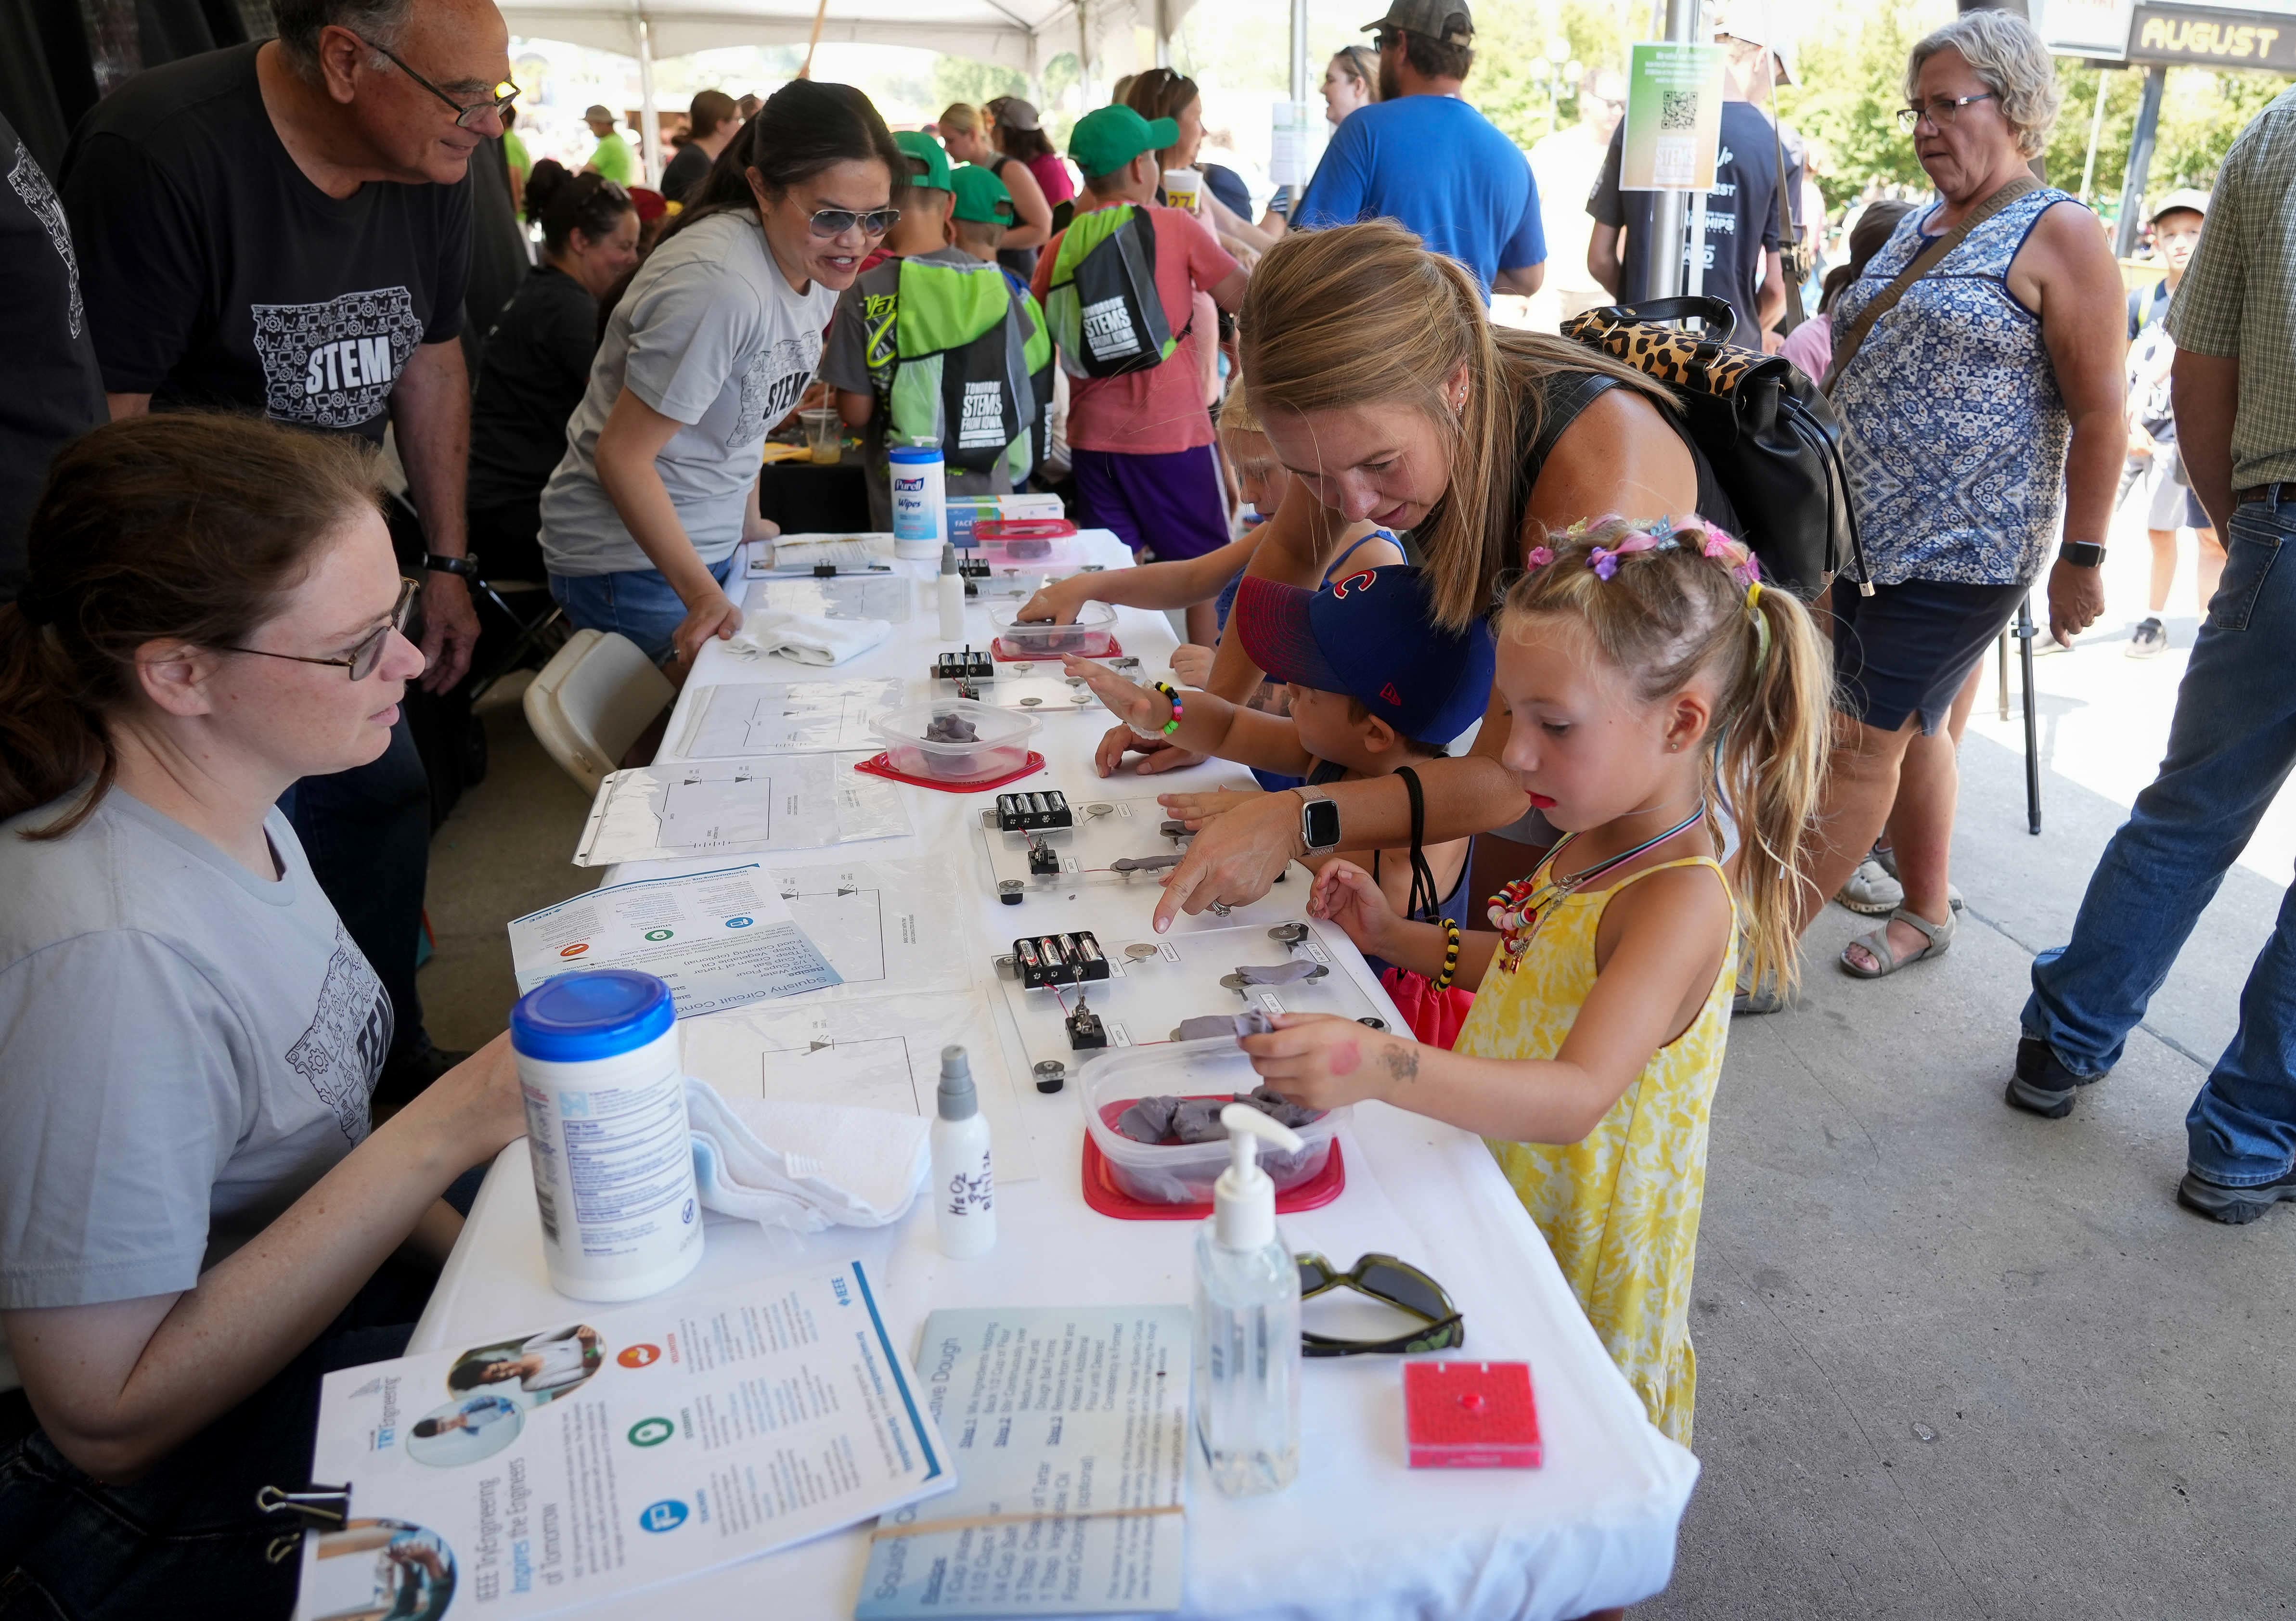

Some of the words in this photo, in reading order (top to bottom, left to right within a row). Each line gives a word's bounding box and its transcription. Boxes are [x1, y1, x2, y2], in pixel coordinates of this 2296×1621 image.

[2141, 18, 2279, 59] AUGUST
[1083, 307, 1132, 339] STEMS
[305, 335, 392, 395] STEM
[963, 394, 1003, 418] STEMS
[961, 417, 980, 431] FROM
[899, 498, 920, 511] Wipes
[1333, 569, 1378, 600] C
[640, 922, 672, 932] STUDENTS
[554, 937, 592, 949] VOLUNTEER
[731, 944, 775, 956] Coloring
[775, 939, 802, 947] Food
[682, 952, 731, 966] (optional)
[716, 951, 767, 965] Vegetable
[736, 956, 772, 965] Cream
[692, 965, 724, 975] Tartar
[734, 969, 762, 978] Flour
[759, 969, 789, 978] Water
[761, 962, 791, 971] Cups
[765, 975, 830, 993] Squishy
[717, 990, 768, 1004] Circuit
[672, 1000, 717, 1014] Cond
[830, 1276, 849, 1298] IEEE
[871, 1537, 914, 1600] Squish
[929, 1337, 964, 1382] Dough
[1030, 1461, 1051, 1494] Tartar
[505, 1456, 533, 1516] Engineers
[1029, 1496, 1045, 1508] of
[475, 1476, 504, 1570] TryEngineering
[507, 1515, 529, 1539] the
[540, 1502, 563, 1570] Tomorrow
[972, 1534, 997, 1567] Cups
[539, 1570, 564, 1586] of
[944, 1564, 968, 1592] Cup
[475, 1570, 501, 1604] IEEE
